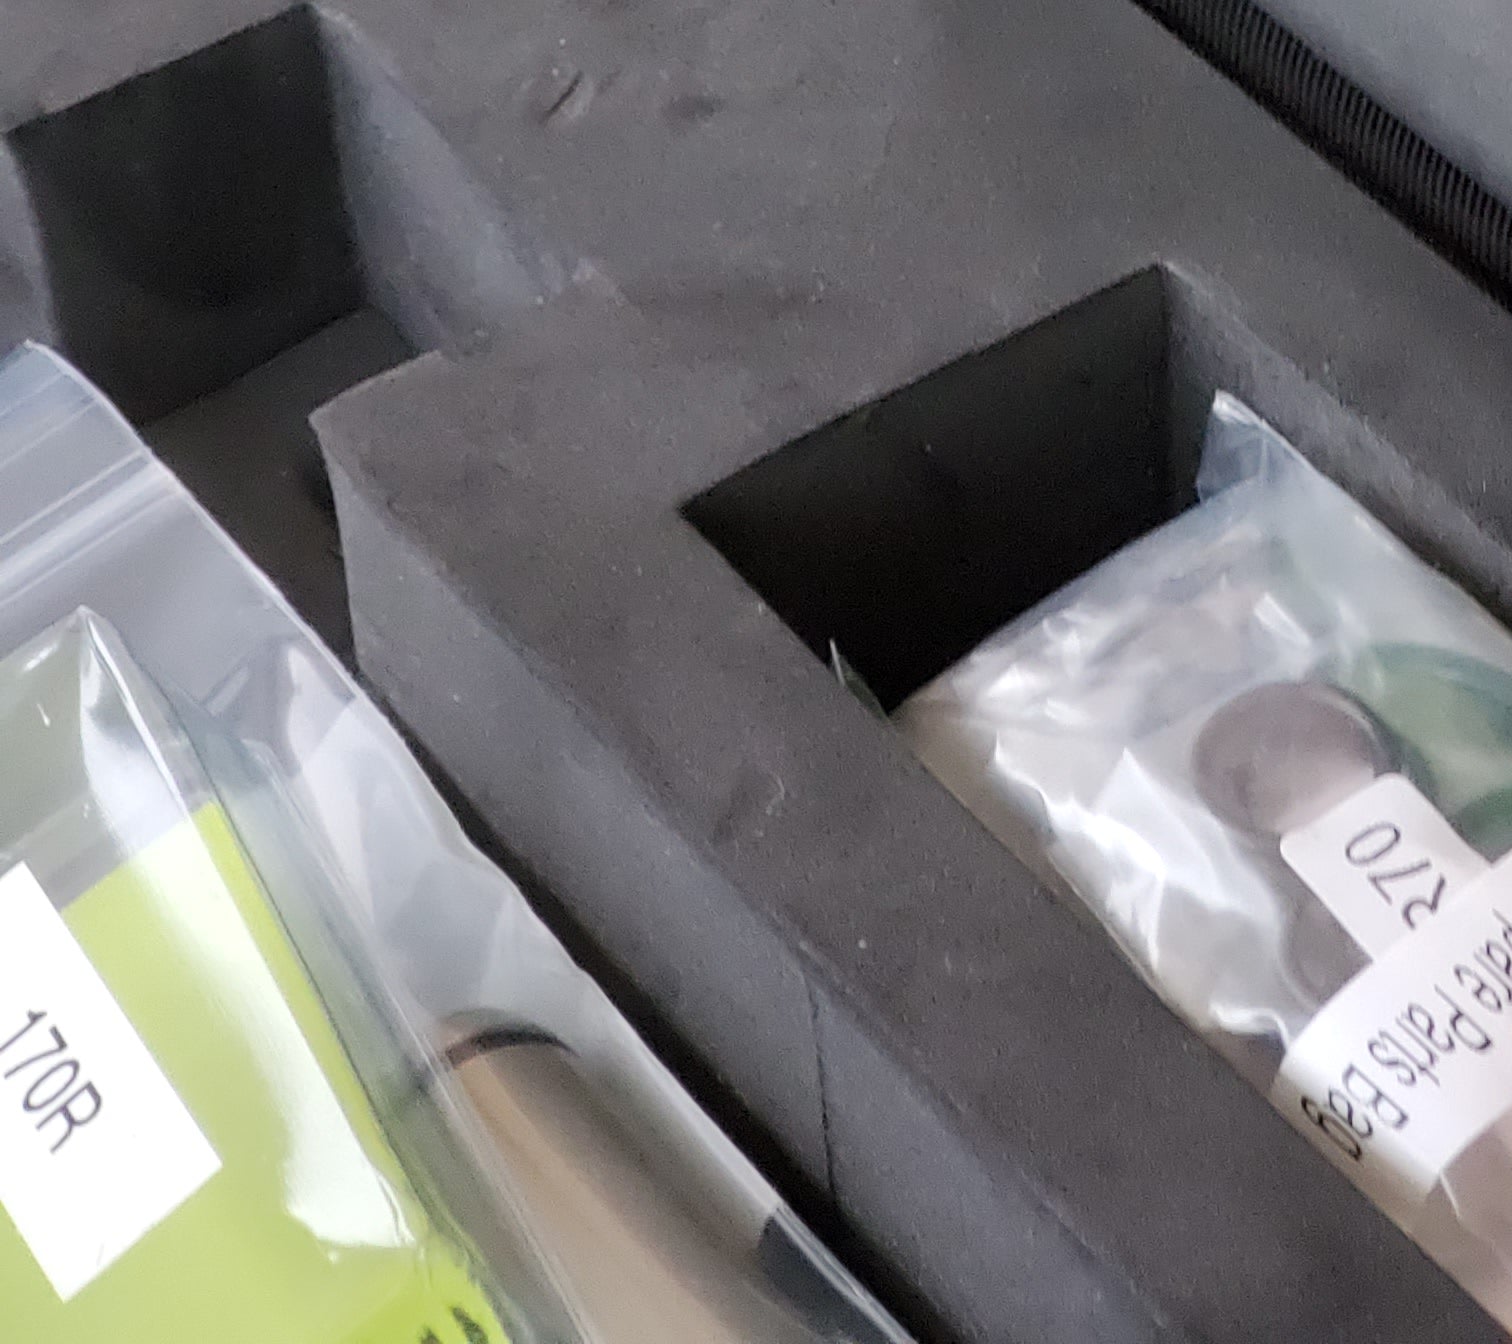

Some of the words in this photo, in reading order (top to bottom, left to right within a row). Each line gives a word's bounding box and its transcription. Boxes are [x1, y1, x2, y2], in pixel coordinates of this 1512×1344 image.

[0, 1009, 103, 1154] 170R
[1368, 984, 1492, 1088] Parts
[1301, 1062, 1408, 1162] Bag
